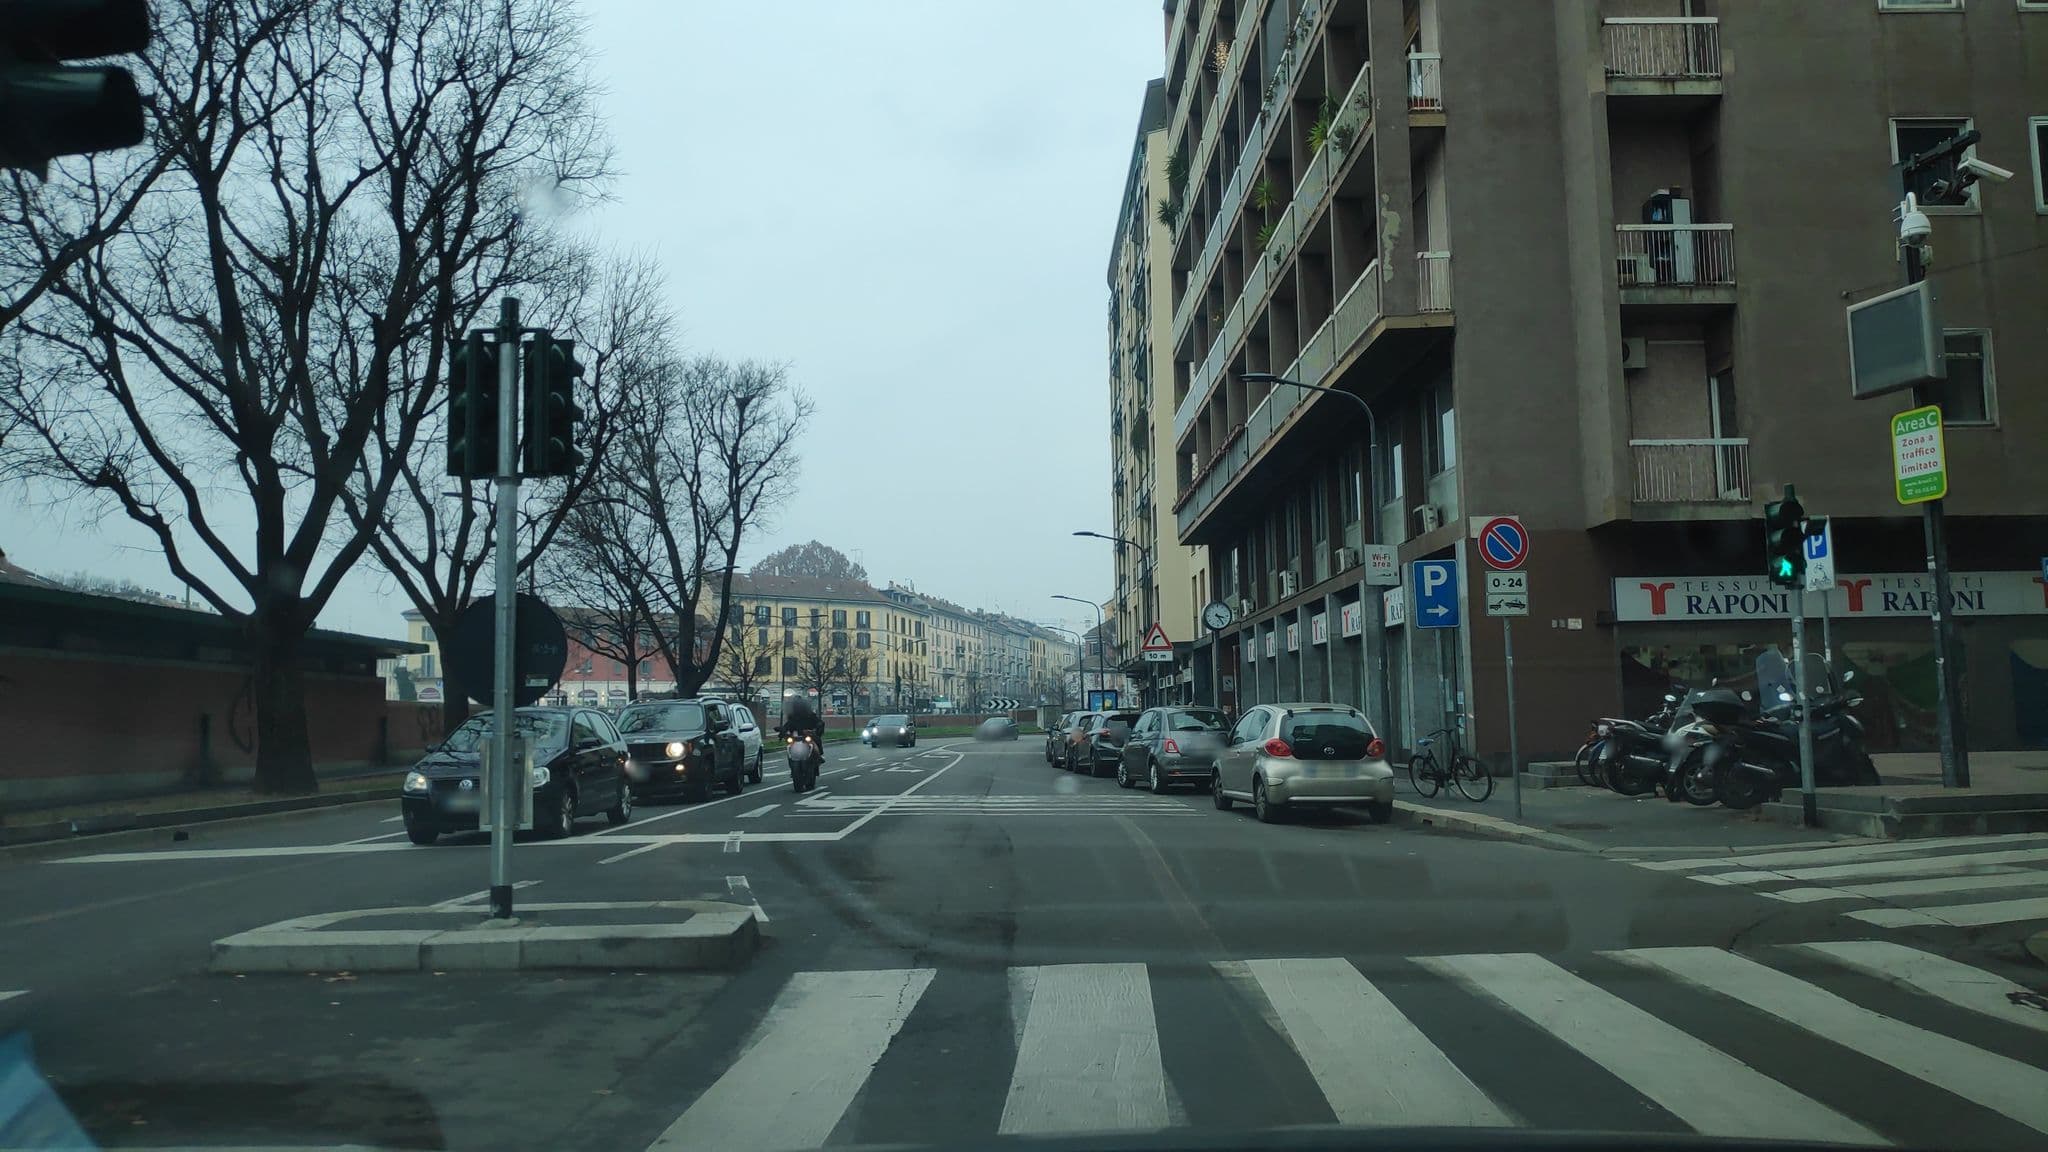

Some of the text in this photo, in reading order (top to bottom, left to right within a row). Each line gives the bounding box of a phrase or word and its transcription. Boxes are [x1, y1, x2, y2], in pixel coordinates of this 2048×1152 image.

[1902, 436, 1925, 447] Zona
[1902, 447, 1936, 460] traffico
[1901, 461, 1938, 474] limitato
[1424, 566, 1447, 596] P
[1683, 580, 1775, 592] TESSUT
[1880, 576, 1984, 589] TESTI
[1686, 593, 1790, 615] RAPONI
[1881, 591, 1986, 612] RAPNI
